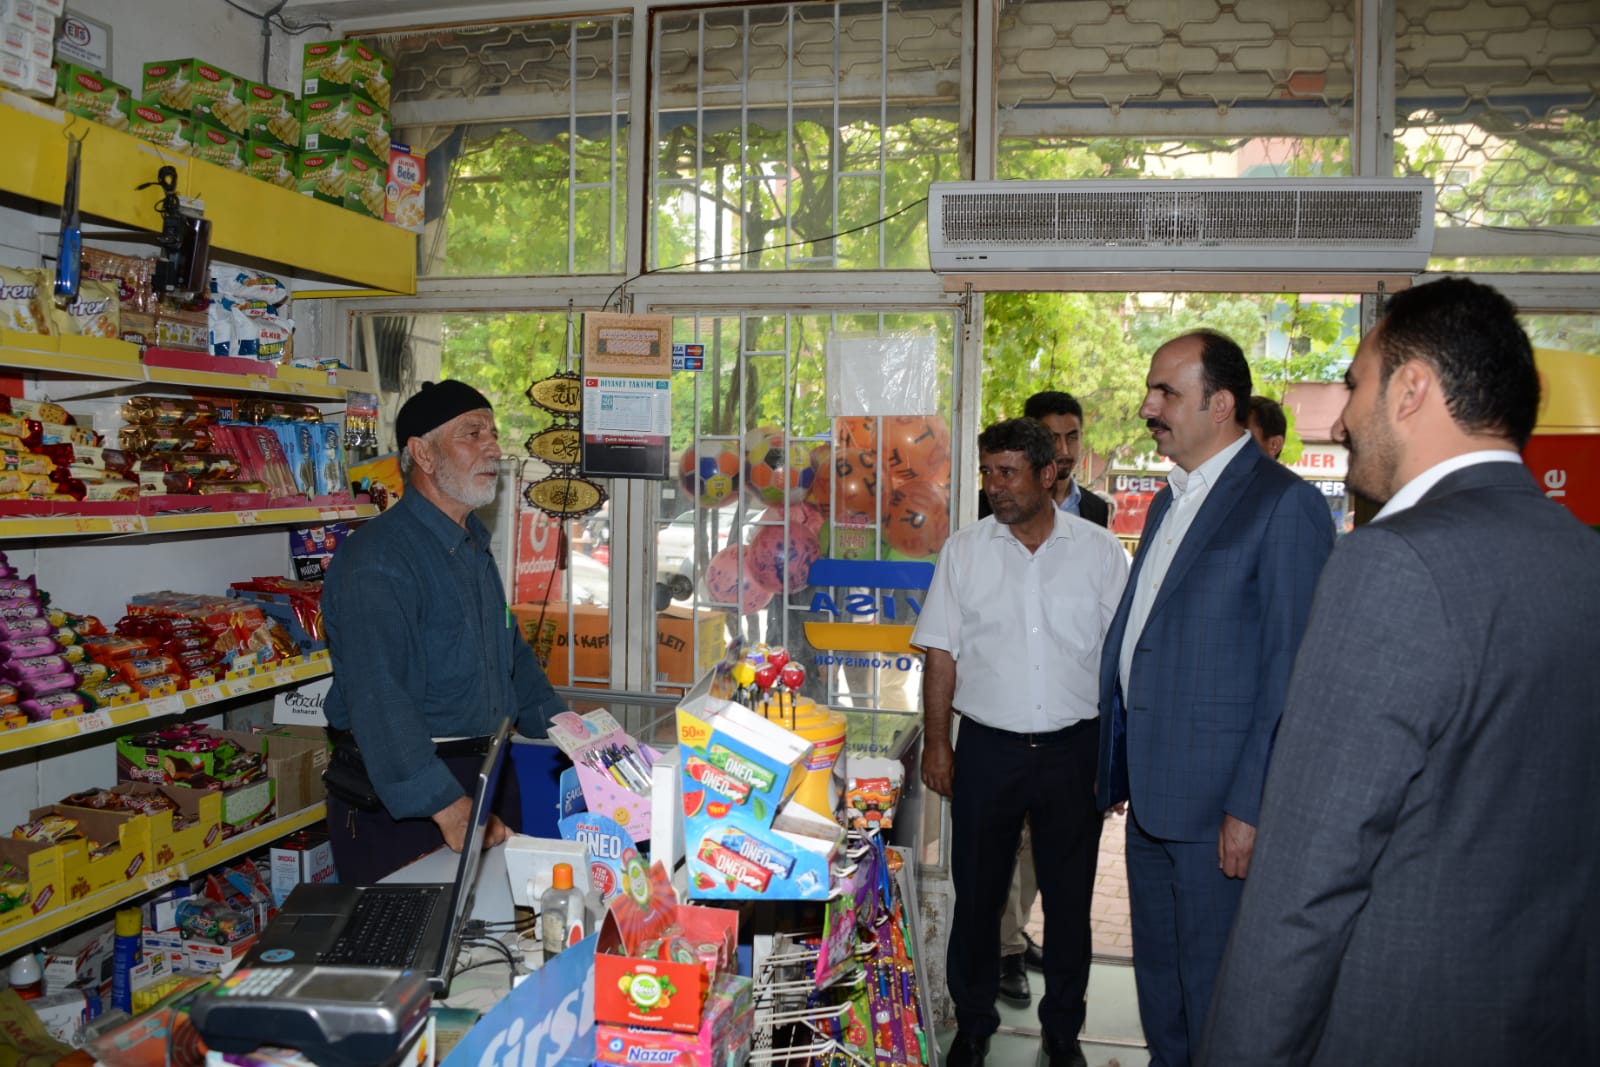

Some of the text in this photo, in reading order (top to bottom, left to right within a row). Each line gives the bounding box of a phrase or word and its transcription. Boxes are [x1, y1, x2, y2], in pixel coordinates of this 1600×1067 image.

[397, 166, 416, 182] Bebe
[701, 769, 729, 794] ONEO
[725, 758, 753, 781] ONEO
[740, 841, 770, 867] ONEO
[716, 855, 746, 880] ONEO
[628, 1046, 679, 1062] Nazar
